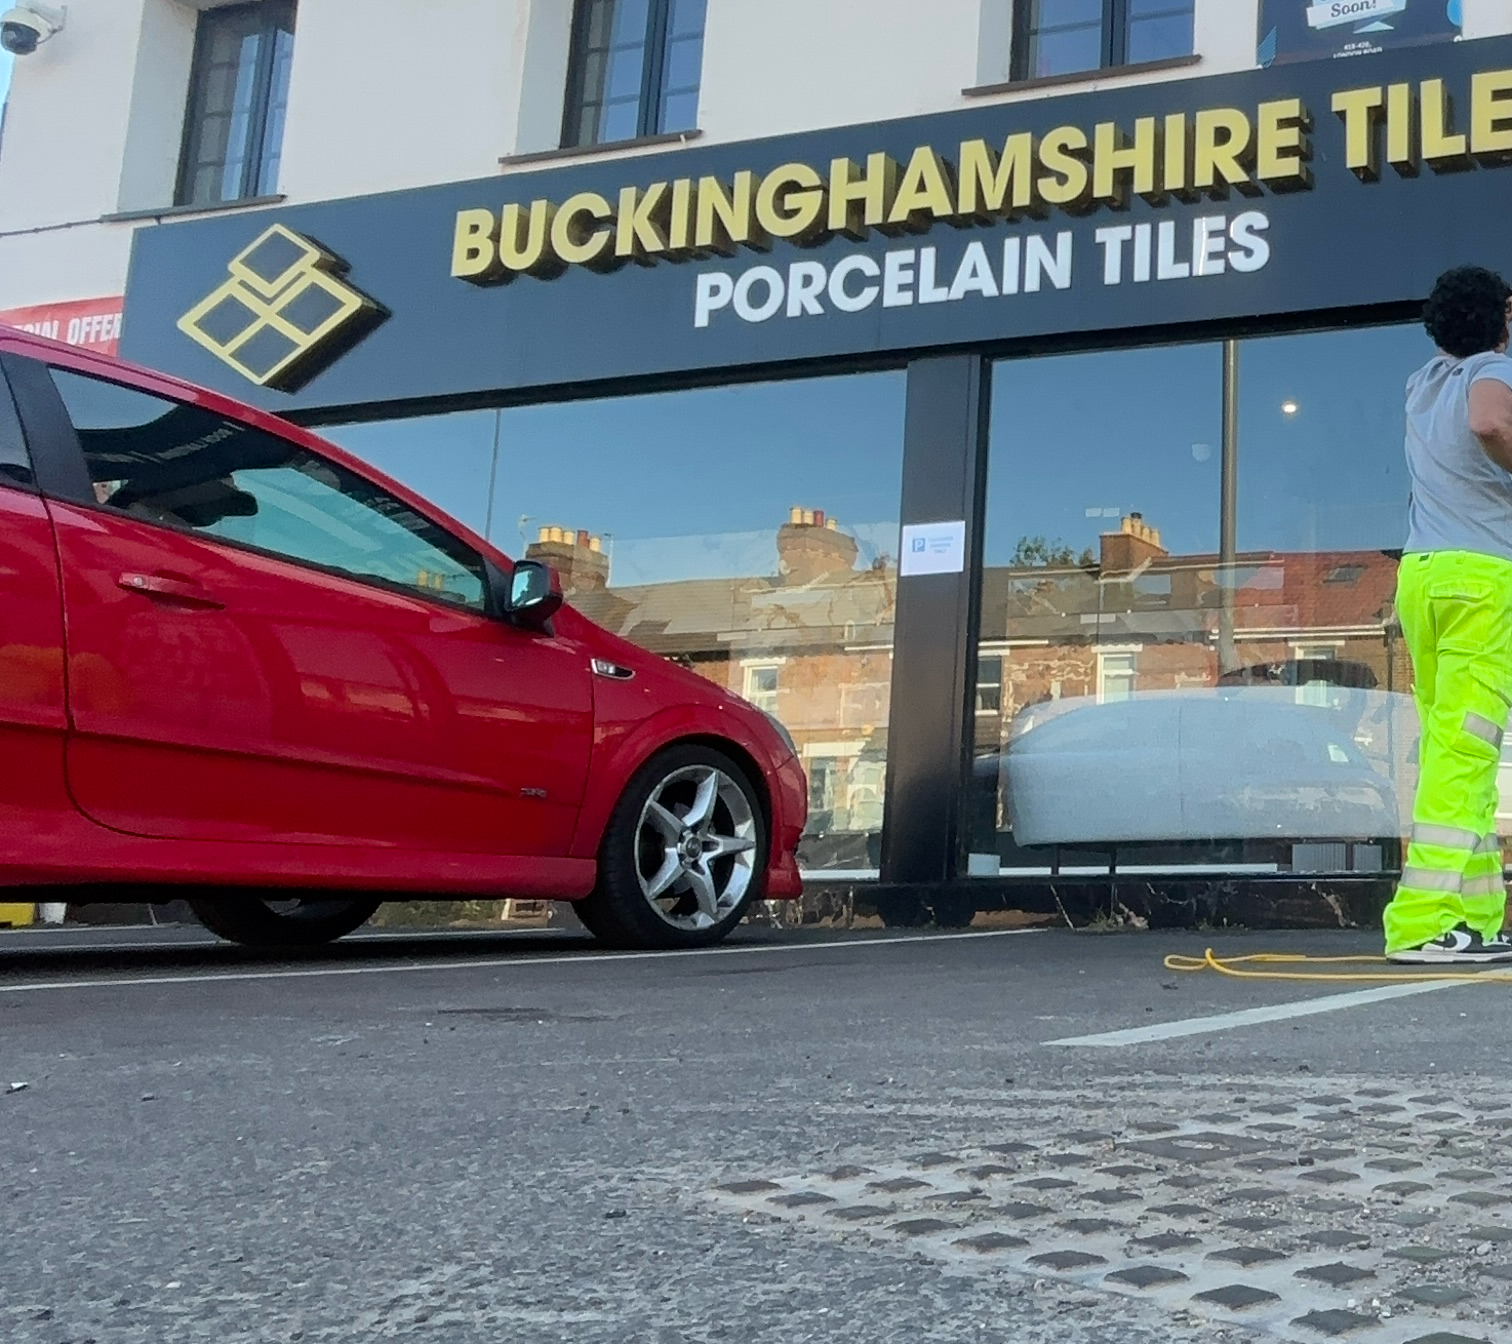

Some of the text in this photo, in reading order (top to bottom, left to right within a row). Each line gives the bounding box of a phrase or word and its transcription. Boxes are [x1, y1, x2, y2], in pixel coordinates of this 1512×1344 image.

[453, 99, 1301, 277] BUCKINGHAMSHIRE
[694, 211, 1270, 328] PORCELAIN TILES
